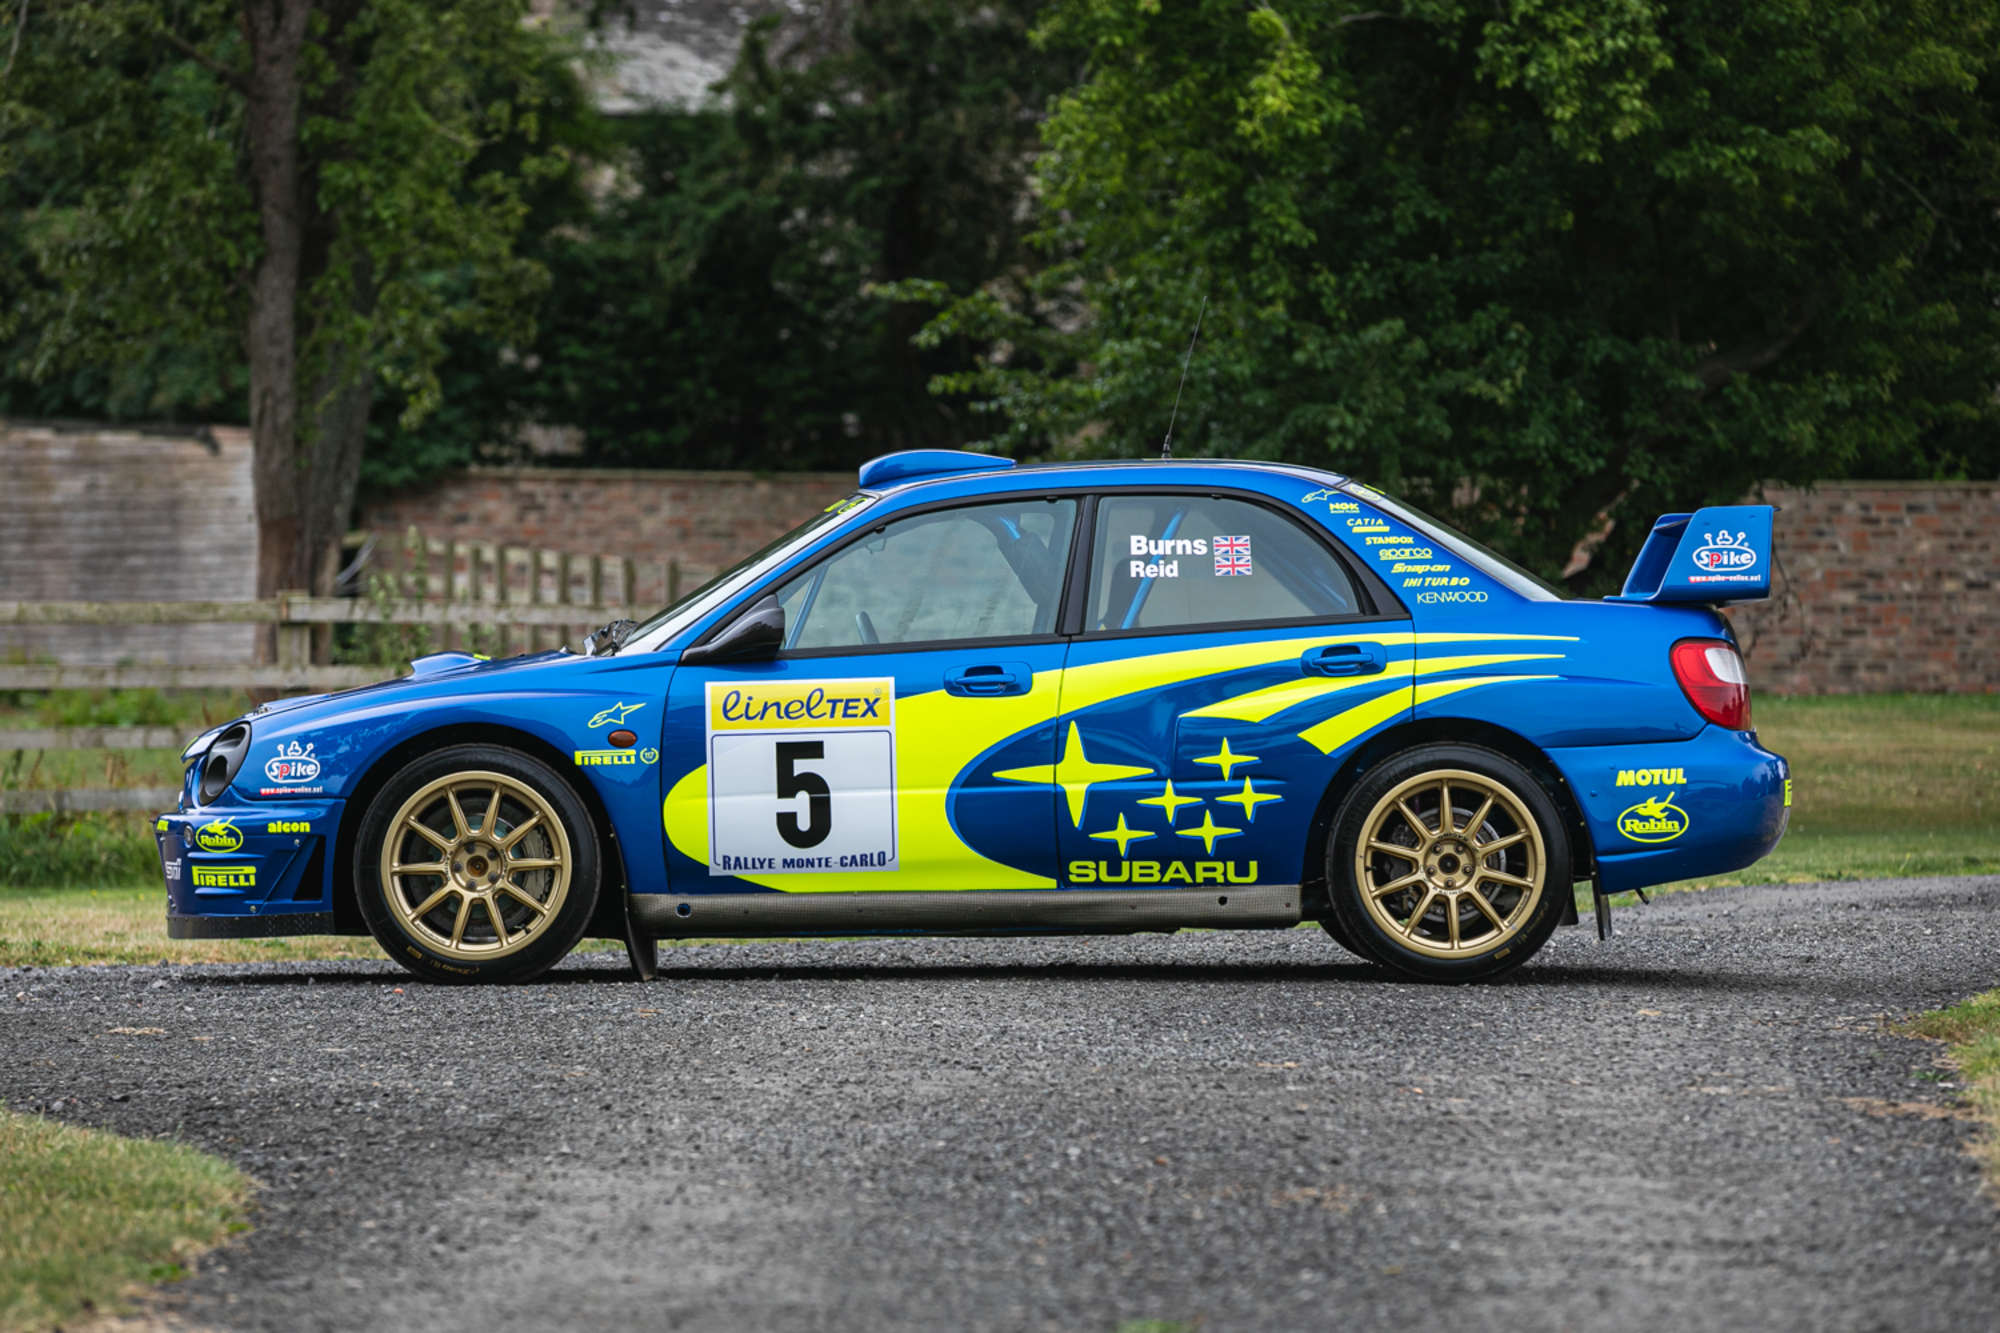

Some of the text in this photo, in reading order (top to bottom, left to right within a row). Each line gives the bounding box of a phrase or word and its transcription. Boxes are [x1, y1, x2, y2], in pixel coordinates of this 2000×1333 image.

[1346, 518, 1384, 526] CATIA
[1130, 535, 1208, 555] Burns
[1365, 536, 1414, 545] STANDOX
[1699, 550, 1752, 568] Spike
[1130, 560, 1178, 578] Reid
[1391, 563, 1451, 574] Snap-on
[1424, 576, 1470, 586] TURBO
[1416, 591, 1488, 604] KENWOOD
[574, 749, 636, 766] PIRELLI
[270, 762, 316, 780] Spike
[1616, 768, 1687, 786] MOTUL
[775, 740, 832, 849] 5
[267, 820, 310, 832] alcon
[1624, 818, 1680, 833] Robin
[200, 834, 237, 847] Robin
[722, 851, 886, 871] RALLYE MONTE-CARLO
[192, 866, 256, 887] PIRELLI
[1068, 860, 1258, 883] SUBARU
